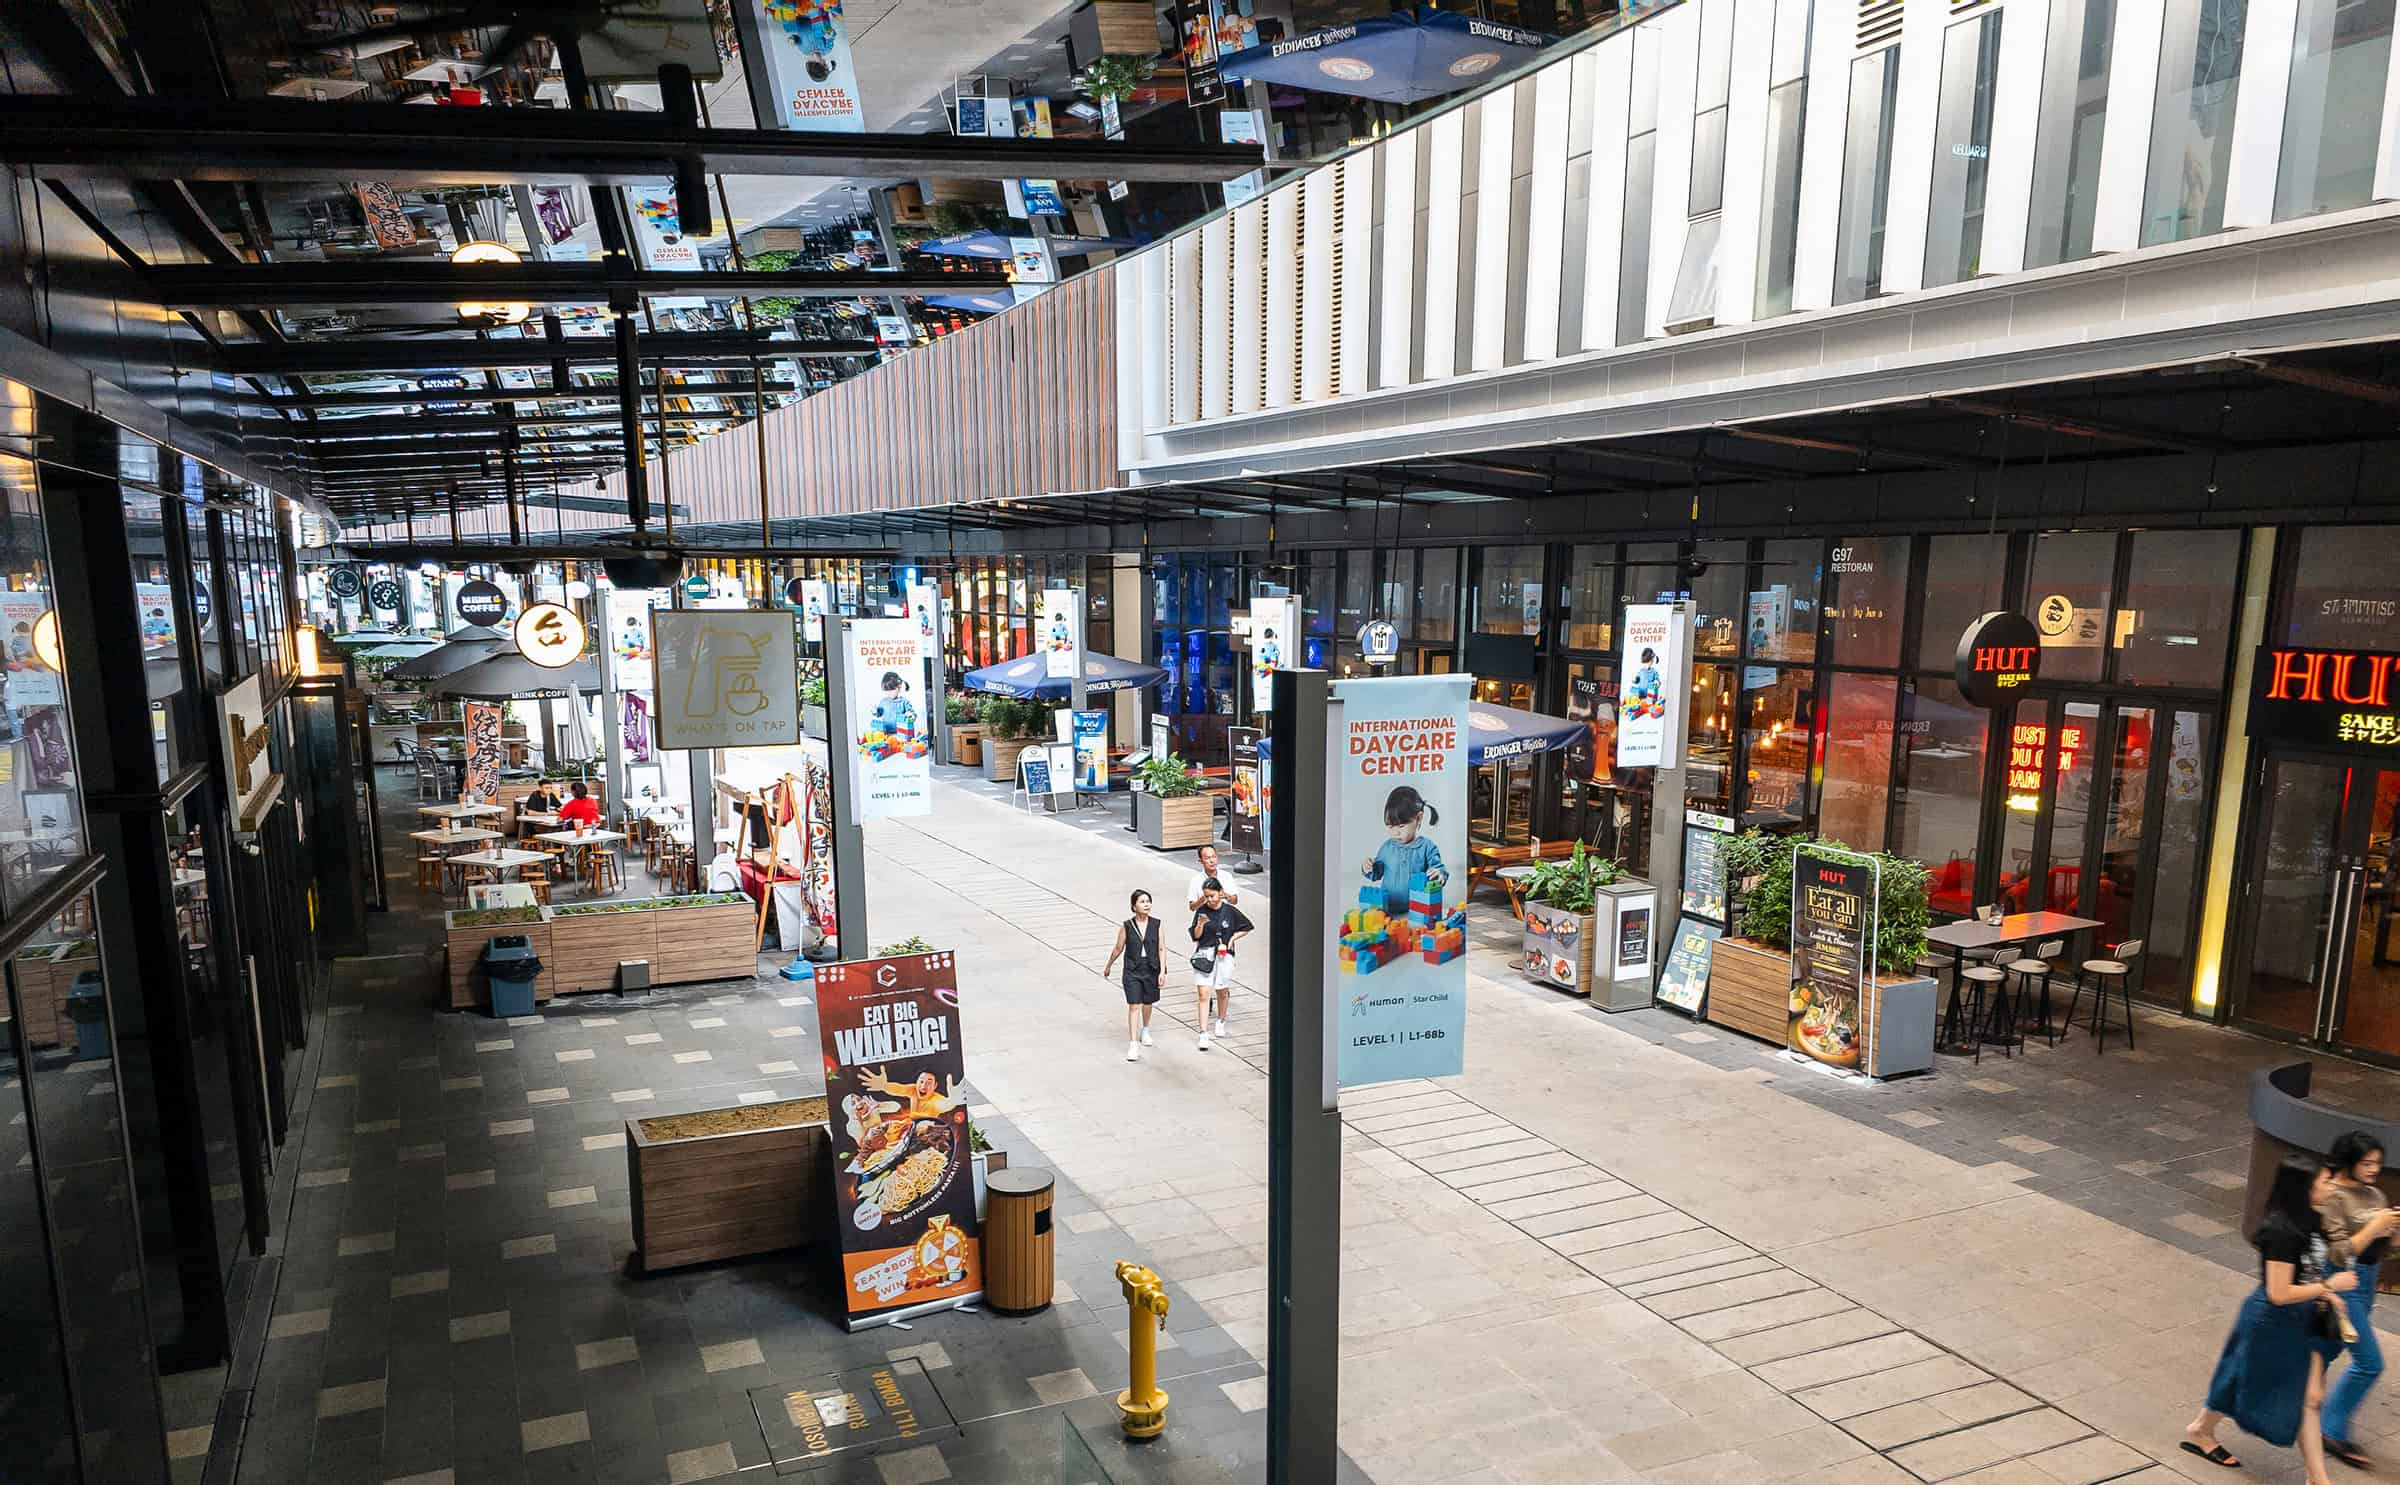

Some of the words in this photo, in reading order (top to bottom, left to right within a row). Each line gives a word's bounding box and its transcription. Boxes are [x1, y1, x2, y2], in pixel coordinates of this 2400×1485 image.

[1832, 547, 1854, 562] G97
[1831, 562, 1874, 573] RESTORAN
[463, 604, 502, 612] COFFEE
[1630, 627, 1667, 635] DAYCARE
[1633, 635, 1663, 643] CENTER
[860, 645, 917, 656] DAYCARE
[1974, 647, 2036, 671] HUT
[867, 656, 912, 666] CENTER
[1576, 679, 1597, 694] THE
[2266, 651, 2400, 706] HU
[735, 722, 755, 733] ON
[762, 721, 787, 732] TAP
[1350, 716, 1456, 734] INTERNATIONAL
[2339, 713, 2395, 731] SAKE
[1350, 731, 1457, 755] DAYCARE
[1484, 741, 1522, 759] ERDINGER
[1360, 753, 1445, 776] CENTER
[1818, 869, 1847, 886] HUT
[1807, 888, 1833, 911] Eat
[1836, 896, 1856, 916] all
[1810, 906, 1830, 920] you
[1832, 911, 1853, 925] can
[1429, 993, 1448, 1002] Child
[863, 1003, 893, 1027] EAT
[894, 1000, 919, 1021] BIG
[833, 1026, 895, 1067] WIN
[894, 1015, 949, 1056] BIG!
[1353, 1034, 1388, 1047] LEVEL
[1390, 1033, 1395, 1042] 1
[1409, 1029, 1446, 1041] L1-68b
[861, 1269, 881, 1286] EAT
[892, 1254, 915, 1272] BOX
[880, 1280, 905, 1296] WIN
[871, 1370, 906, 1408] BOMBA
[891, 1408, 921, 1439] PILI
